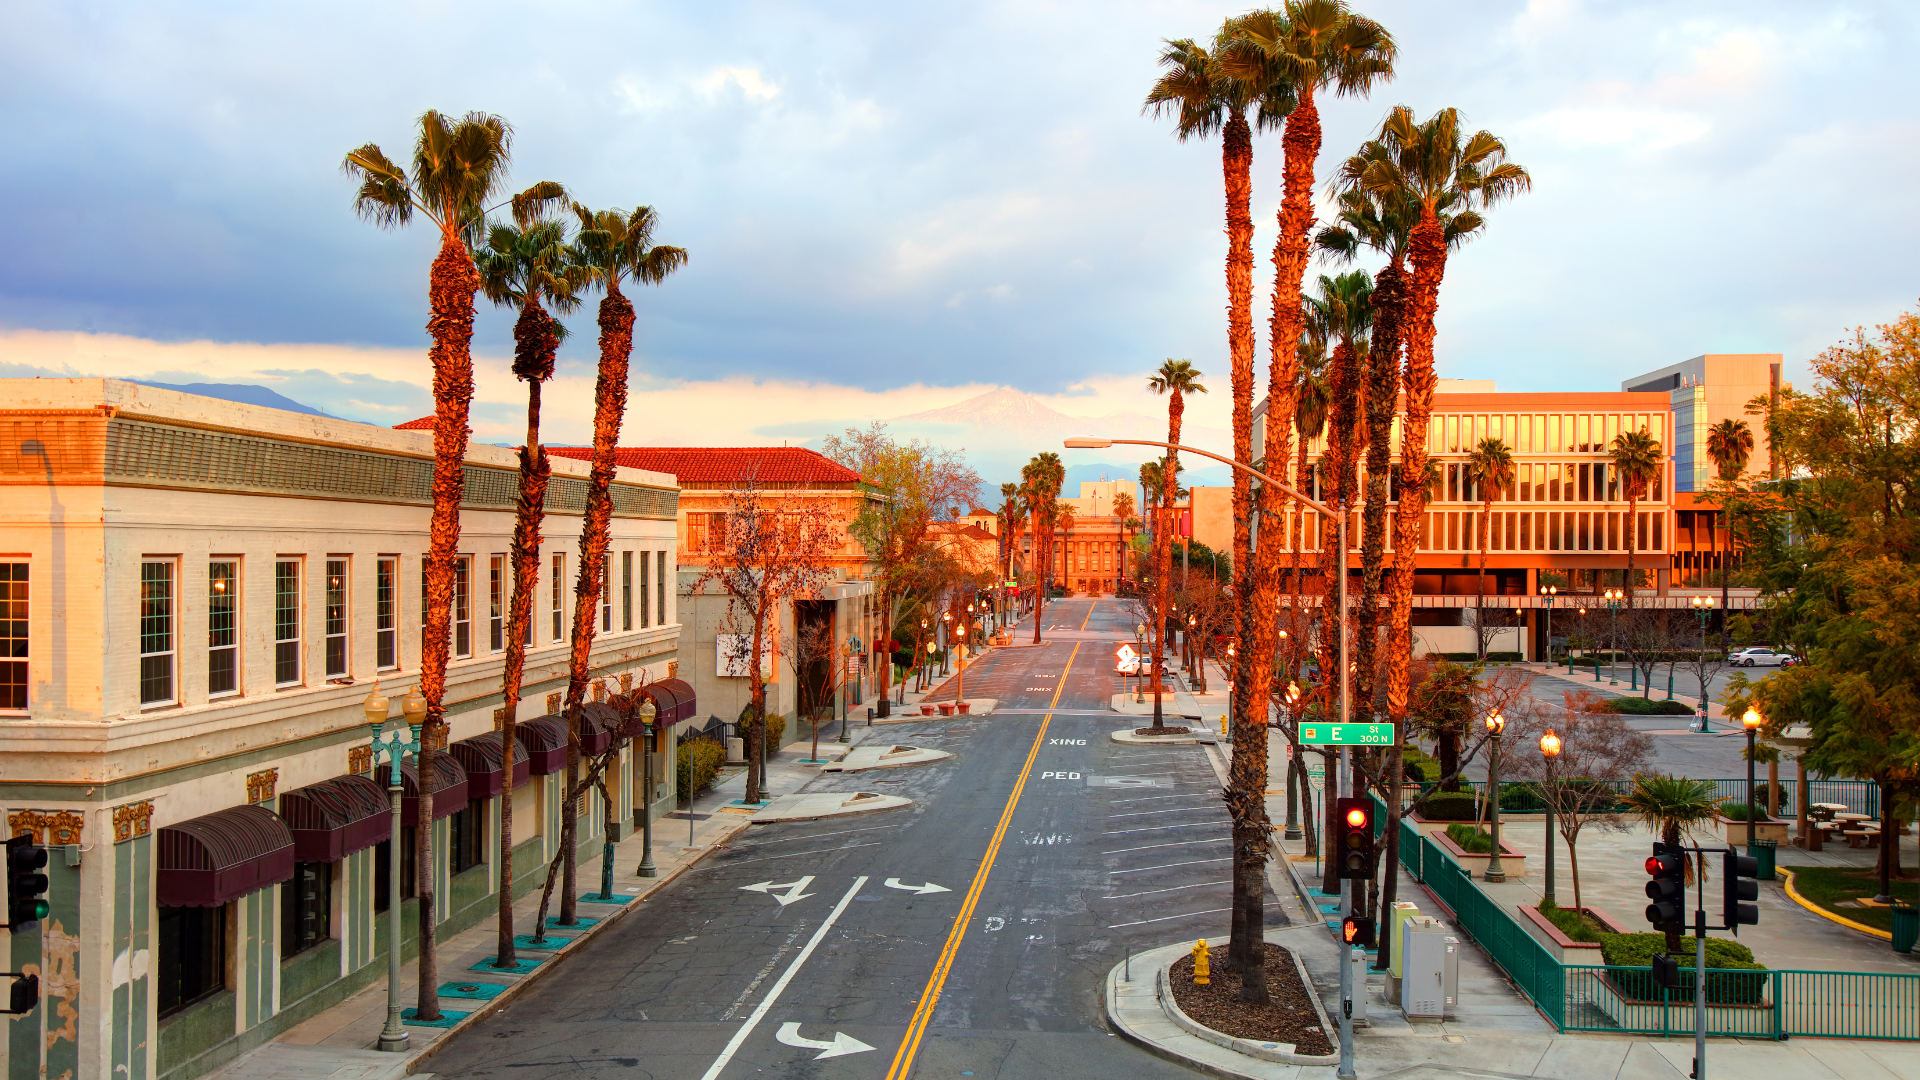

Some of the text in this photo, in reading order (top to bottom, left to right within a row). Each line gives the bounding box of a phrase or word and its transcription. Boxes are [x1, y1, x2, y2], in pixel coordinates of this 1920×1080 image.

[1331, 726, 1379, 741] E St
[1049, 738, 1087, 746] XING
[1360, 735, 1388, 743] 300 N
[1041, 771, 1081, 780] PED
